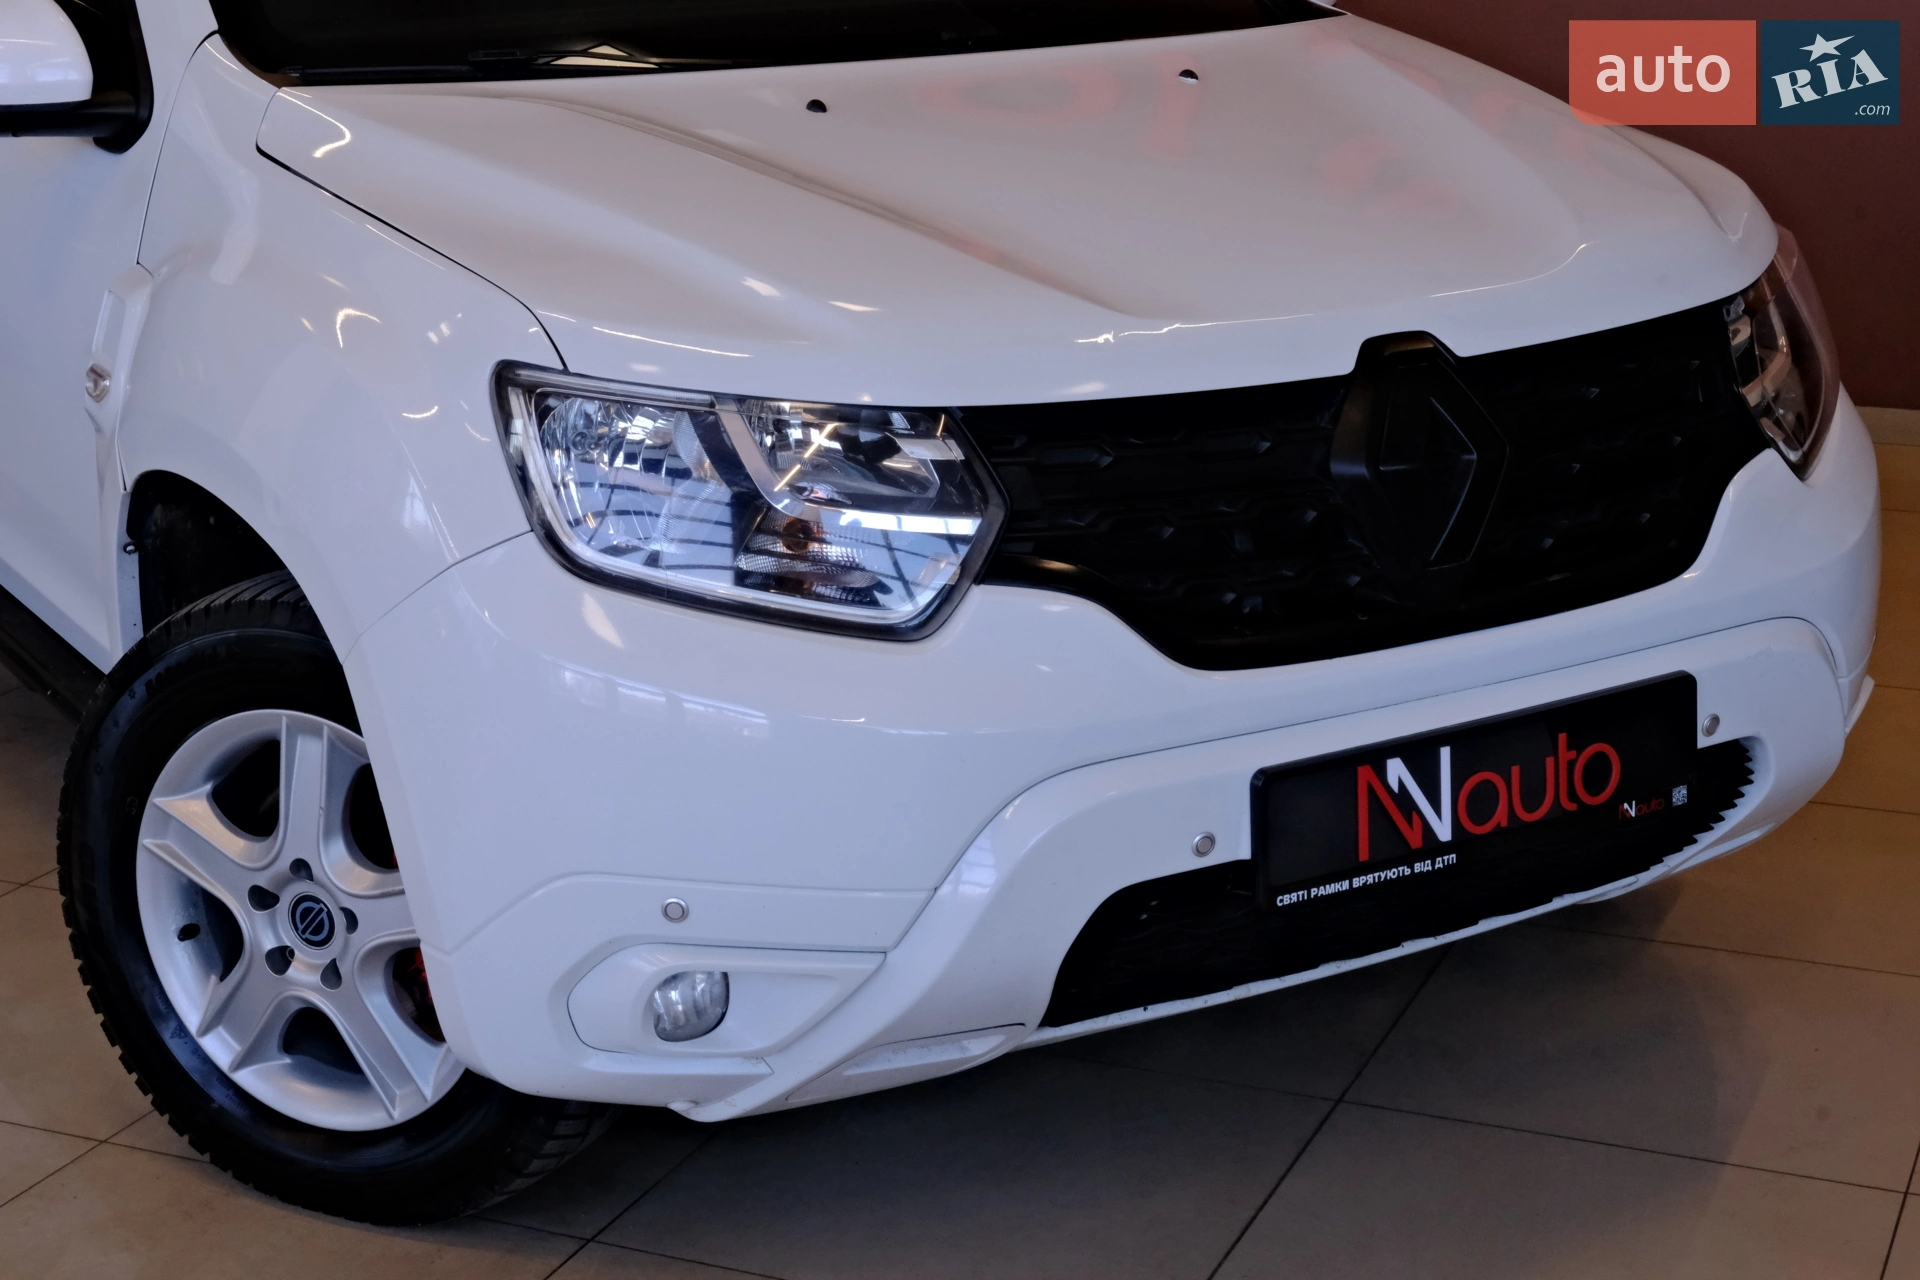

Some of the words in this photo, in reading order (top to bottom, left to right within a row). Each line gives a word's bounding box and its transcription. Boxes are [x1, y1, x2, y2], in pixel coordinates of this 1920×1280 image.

[1276, 889, 1308, 907] СВЯТІ
[1310, 879, 1350, 899] РАМКИ
[1352, 866, 1411, 888] ВРЯТУЮТЬ
[1414, 859, 1432, 873] ВІД
[1434, 853, 1457, 870] ДТП
